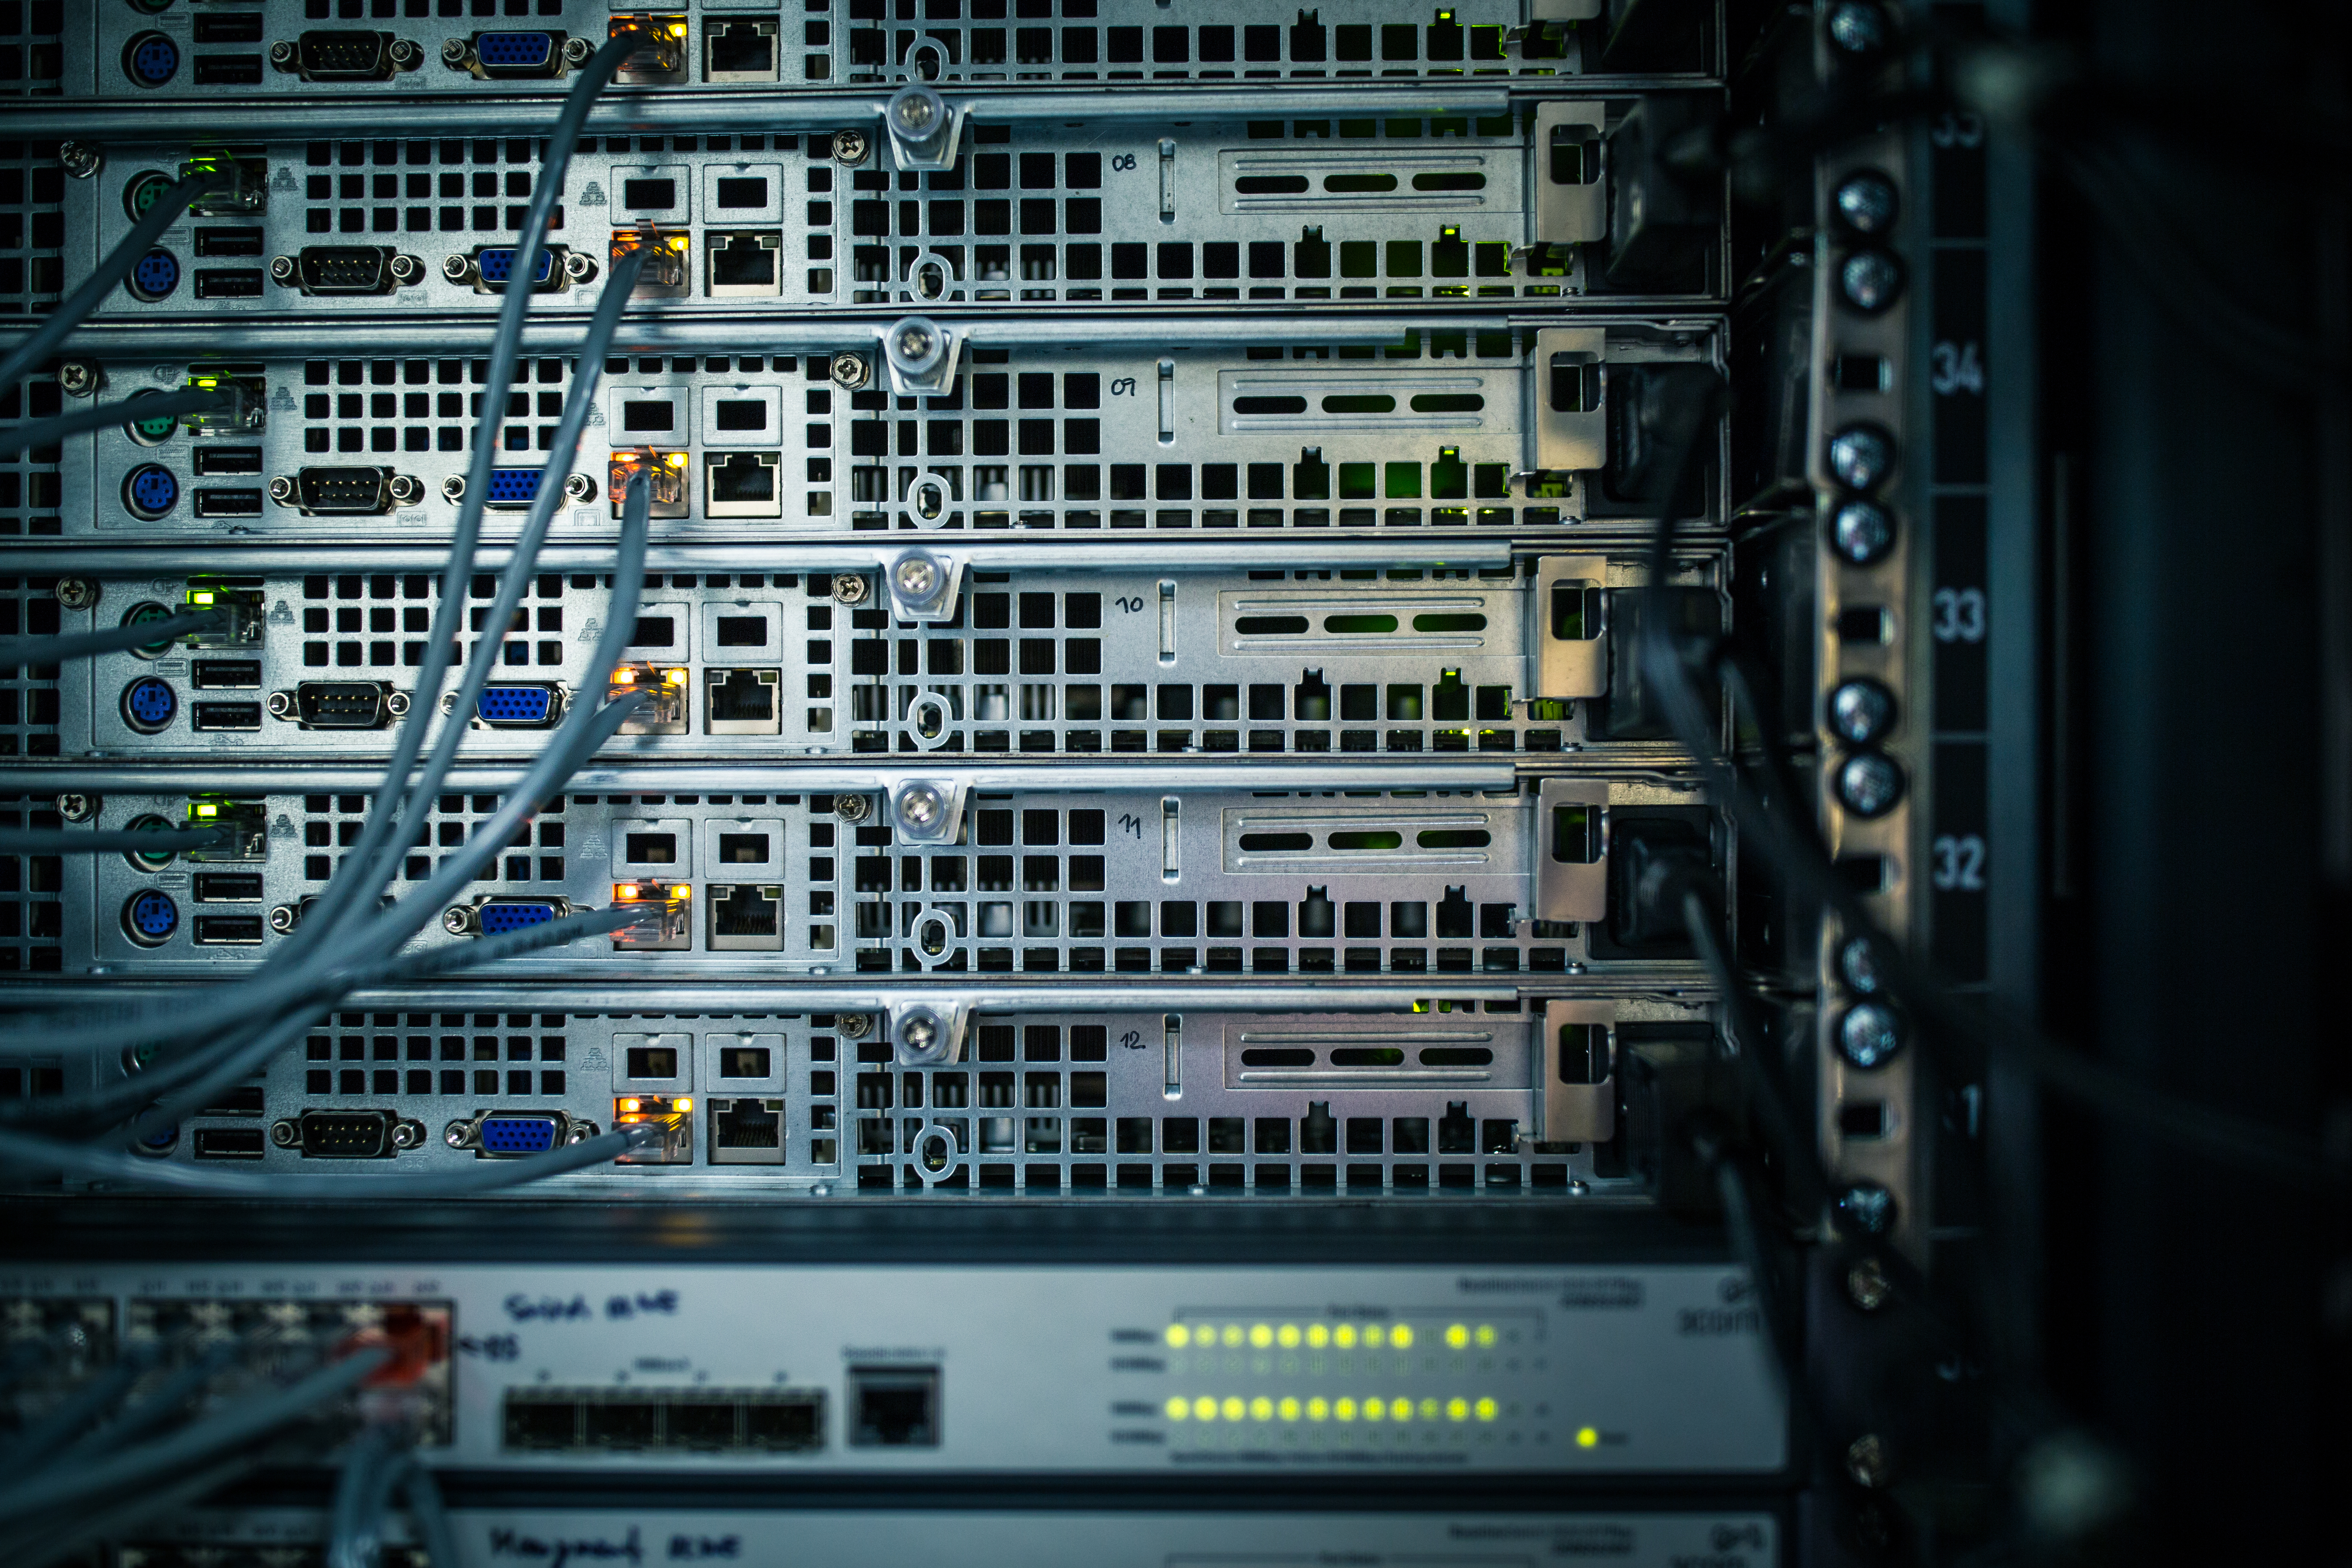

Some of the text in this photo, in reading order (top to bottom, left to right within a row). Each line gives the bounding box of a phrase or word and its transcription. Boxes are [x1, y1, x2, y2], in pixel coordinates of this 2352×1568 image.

[1112, 154, 1137, 172] 08
[1931, 340, 1984, 395] 34
[1115, 597, 1144, 613] 10
[1933, 586, 1985, 642] 33
[1118, 813, 1141, 839] 11
[1933, 834, 1986, 889] 32
[1120, 1031, 1146, 1049] 12
